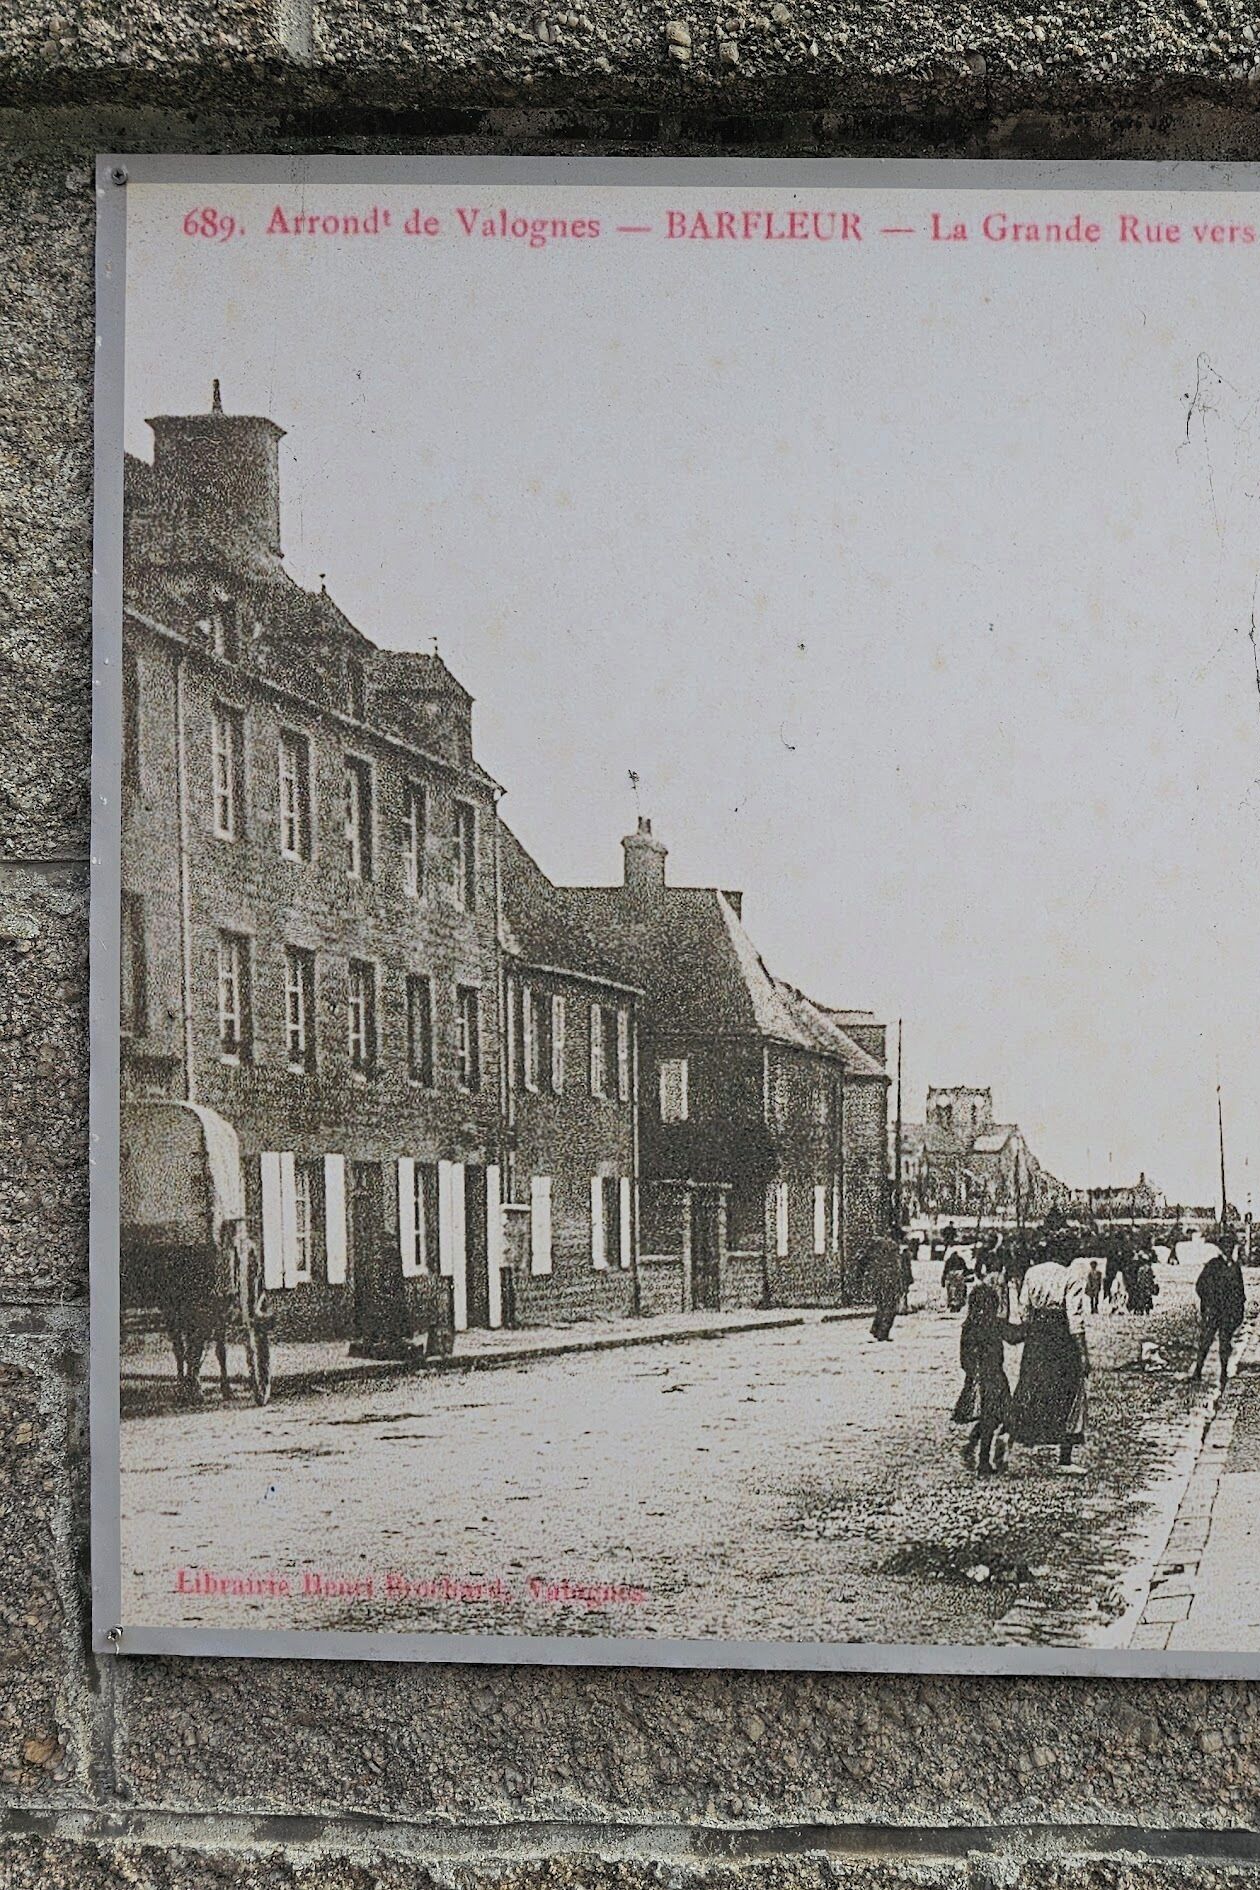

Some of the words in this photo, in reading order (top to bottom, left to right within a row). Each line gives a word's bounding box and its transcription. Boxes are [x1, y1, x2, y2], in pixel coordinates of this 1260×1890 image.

[182, 206, 246, 242] 689.
[403, 208, 440, 237] de
[456, 207, 600, 249] Valognes
[667, 209, 863, 241] BARFLEUR
[931, 212, 967, 241] La
[981, 212, 1102, 244] Grande
[1119, 213, 1181, 245] Rue
[1193, 224, 1256, 244] vers
[176, 1568, 291, 1598] Librairie
[301, 1571, 375, 1599] Henri
[527, 1575, 646, 1609] Valognes
